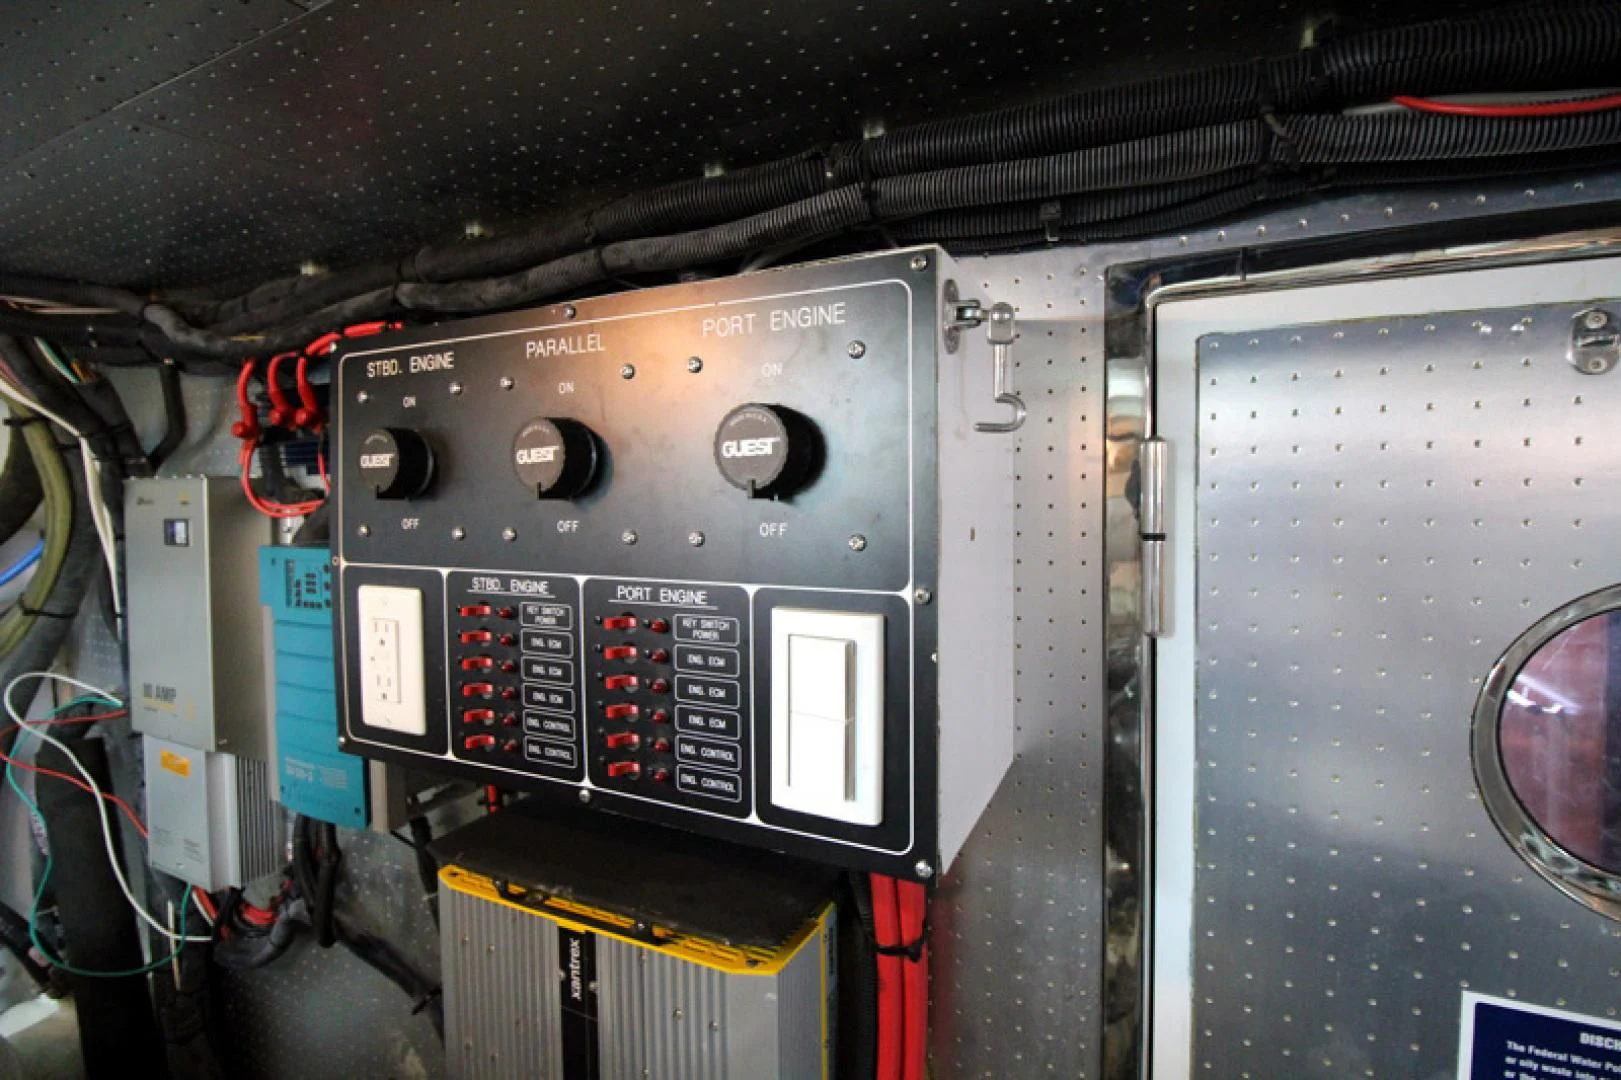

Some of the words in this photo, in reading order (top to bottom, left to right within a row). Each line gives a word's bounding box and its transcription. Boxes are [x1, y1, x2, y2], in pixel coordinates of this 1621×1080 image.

[702, 314, 757, 338] PORT
[770, 302, 847, 332] ENGINE
[526, 334, 606, 358] PARALLEL
[367, 360, 402, 378] STBD.
[409, 352, 455, 373] ENGINE
[761, 362, 783, 378] ON
[559, 382, 574, 394] ON
[403, 396, 416, 408] ON
[516, 446, 560, 464] GUEST
[722, 437, 780, 458] GUEST
[360, 453, 395, 468] GUEST
[401, 518, 420, 530] OFF
[557, 520, 579, 533] OFF
[759, 522, 787, 537] OFF
[471, 577, 504, 590] STBD.
[510, 579, 550, 594] ENGINE
[617, 585, 652, 601] PORT
[660, 588, 708, 605] ENGINE
[708, 655, 726, 667] ECM
[708, 686, 726, 698] ECM
[708, 717, 726, 729] ECM
[701, 747, 736, 762] CONTROL
[701, 777, 736, 792] CONTROL
[569, 938, 581, 1000] xantrex
[1507, 1040, 1525, 1053] The
[1528, 1044, 1568, 1062] Federal
[1570, 1054, 1602, 1069] Water
[1505, 1056, 1517, 1065] or
[1519, 1059, 1538, 1071] oily
[1541, 1064, 1573, 1077] waste
